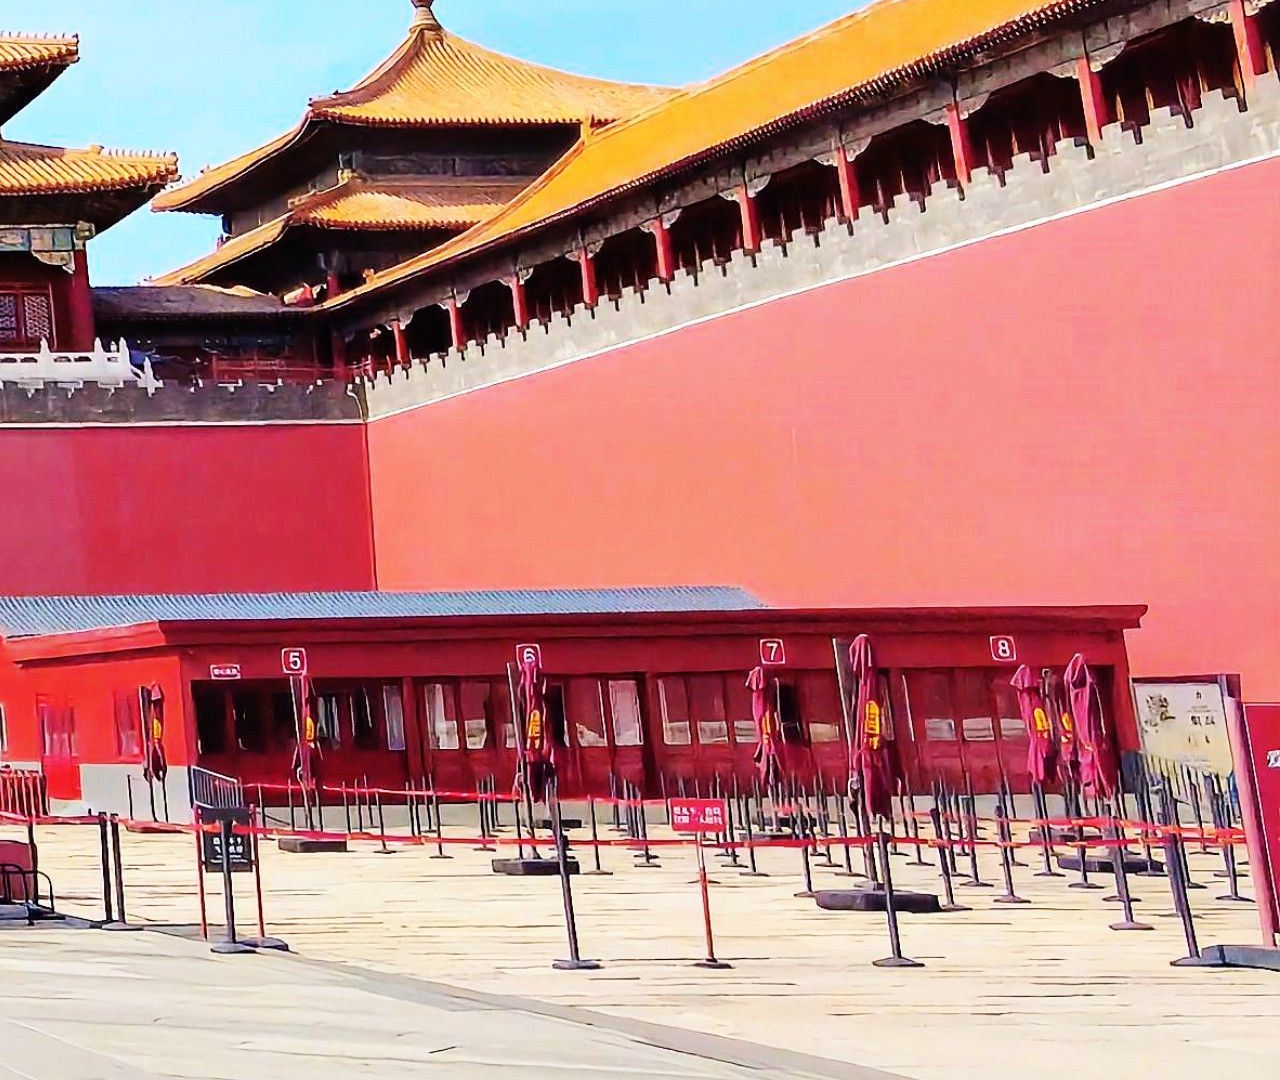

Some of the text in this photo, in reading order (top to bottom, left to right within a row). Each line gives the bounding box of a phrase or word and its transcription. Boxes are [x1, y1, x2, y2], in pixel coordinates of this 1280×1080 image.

[523, 647, 536, 663] 6
[766, 642, 778, 661] 7
[998, 639, 1010, 657] 8
[289, 652, 300, 669] 5
